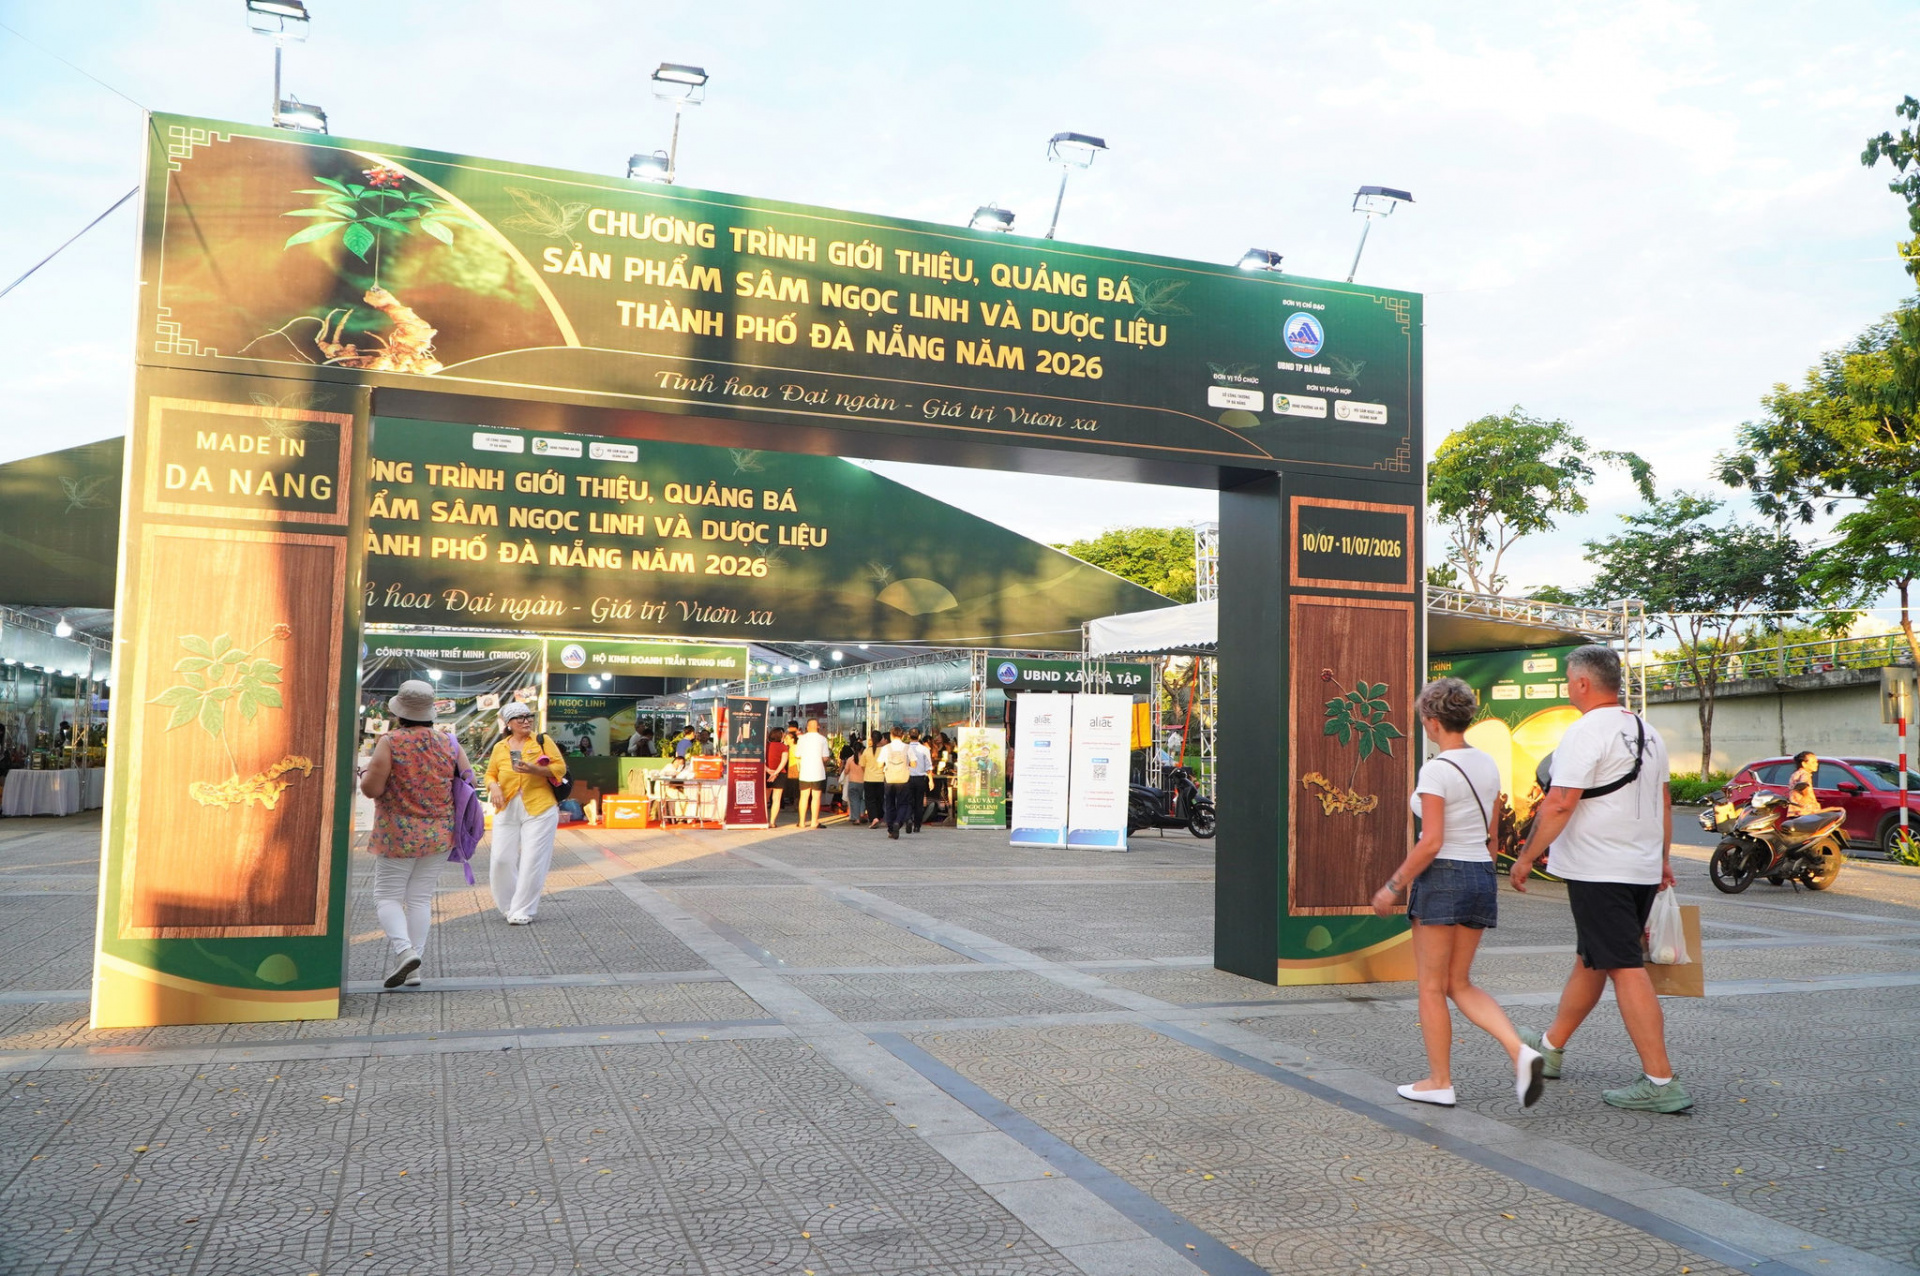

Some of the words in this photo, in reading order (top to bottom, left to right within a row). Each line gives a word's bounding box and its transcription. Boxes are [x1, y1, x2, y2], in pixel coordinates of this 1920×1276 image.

[587, 207, 716, 249] CHƯƠNG
[729, 226, 816, 263] TRÌNH
[828, 239, 883, 271] GIỚI
[894, 248, 980, 287] THIỆU,
[990, 261, 1088, 299] QUẢNG
[1097, 275, 1136, 305] BÁ
[543, 242, 611, 280] SẢN
[624, 253, 723, 294] PHẨM
[735, 269, 810, 304] SÂM
[821, 282, 899, 318] NGỌC
[909, 292, 969, 324] LINH
[980, 299, 1021, 331] VÀ
[1031, 307, 1105, 343] DƯỢC
[1114, 317, 1168, 351] LIỆU
[616, 299, 724, 338] THÀNH
[735, 312, 798, 345] PHỐ
[808, 318, 855, 352] ĐÀ
[865, 323, 945, 362] NẴNG
[955, 338, 1026, 371] NĂM
[1035, 350, 1104, 380] 2026
[1226, 374, 1234, 383] VỊ
[1277, 361, 1295, 372] UBND
[1295, 363, 1304, 372] TP
[1304, 363, 1313, 374] ĐÀ
[654, 371, 719, 394] Tinh
[723, 376, 773, 400] hoa
[779, 384, 829, 406] Đại
[834, 391, 899, 413] ngàn
[922, 397, 966, 420] Giá
[971, 403, 999, 424] trị
[1003, 405, 1067, 429] Vươn
[1069, 416, 1100, 432] xa
[1319, 385, 1326, 394] VỊ
[196, 430, 271, 455] MADE
[280, 438, 306, 457] IN
[164, 463, 214, 493] DA
[229, 468, 332, 500] NANG
[425, 462, 505, 491] TRÌNH
[515, 468, 566, 495] GIỚI
[576, 474, 655, 505] THIỆU,
[663, 480, 754, 509] QUẢNG
[763, 487, 798, 513] BÁ
[431, 498, 499, 527] SÂM
[509, 506, 580, 535] NGỌC
[589, 510, 645, 537] LINH
[654, 513, 693, 539] VÀ
[702, 519, 770, 547] DƯỢC
[778, 522, 828, 551] LIỆU
[431, 533, 488, 561] PHỐ
[497, 538, 539, 566] ĐÀ
[549, 538, 622, 569] NẴNG
[631, 547, 696, 574] NĂM
[704, 554, 768, 578] 2026
[1302, 533, 1335, 554] 10/07
[1341, 535, 1401, 558] 11/07/2026
[384, 582, 436, 610] hoa
[442, 588, 496, 616] Đại
[500, 595, 568, 621] ngàn
[591, 596, 637, 624] Giá
[640, 600, 669, 624] trị
[675, 599, 741, 625] Vươn
[744, 609, 777, 626] xa
[375, 646, 403, 657] CÔNG
[404, 649, 415, 658] TY
[416, 649, 439, 658] TNHH
[440, 647, 461, 658] TRIẾT
[462, 650, 485, 659] MINH
[489, 650, 531, 661] (TRIMICO)
[592, 652, 607, 665] HỘ
[608, 655, 629, 664] KINH
[630, 656, 663, 665] DOANH
[664, 654, 686, 666] TRẦN
[688, 658, 716, 667] TRUNG
[717, 656, 736, 667] HIẾU
[1023, 670, 1061, 682] UBND
[1116, 672, 1142, 688] TẬP
[558, 699, 584, 709] NGỌC
